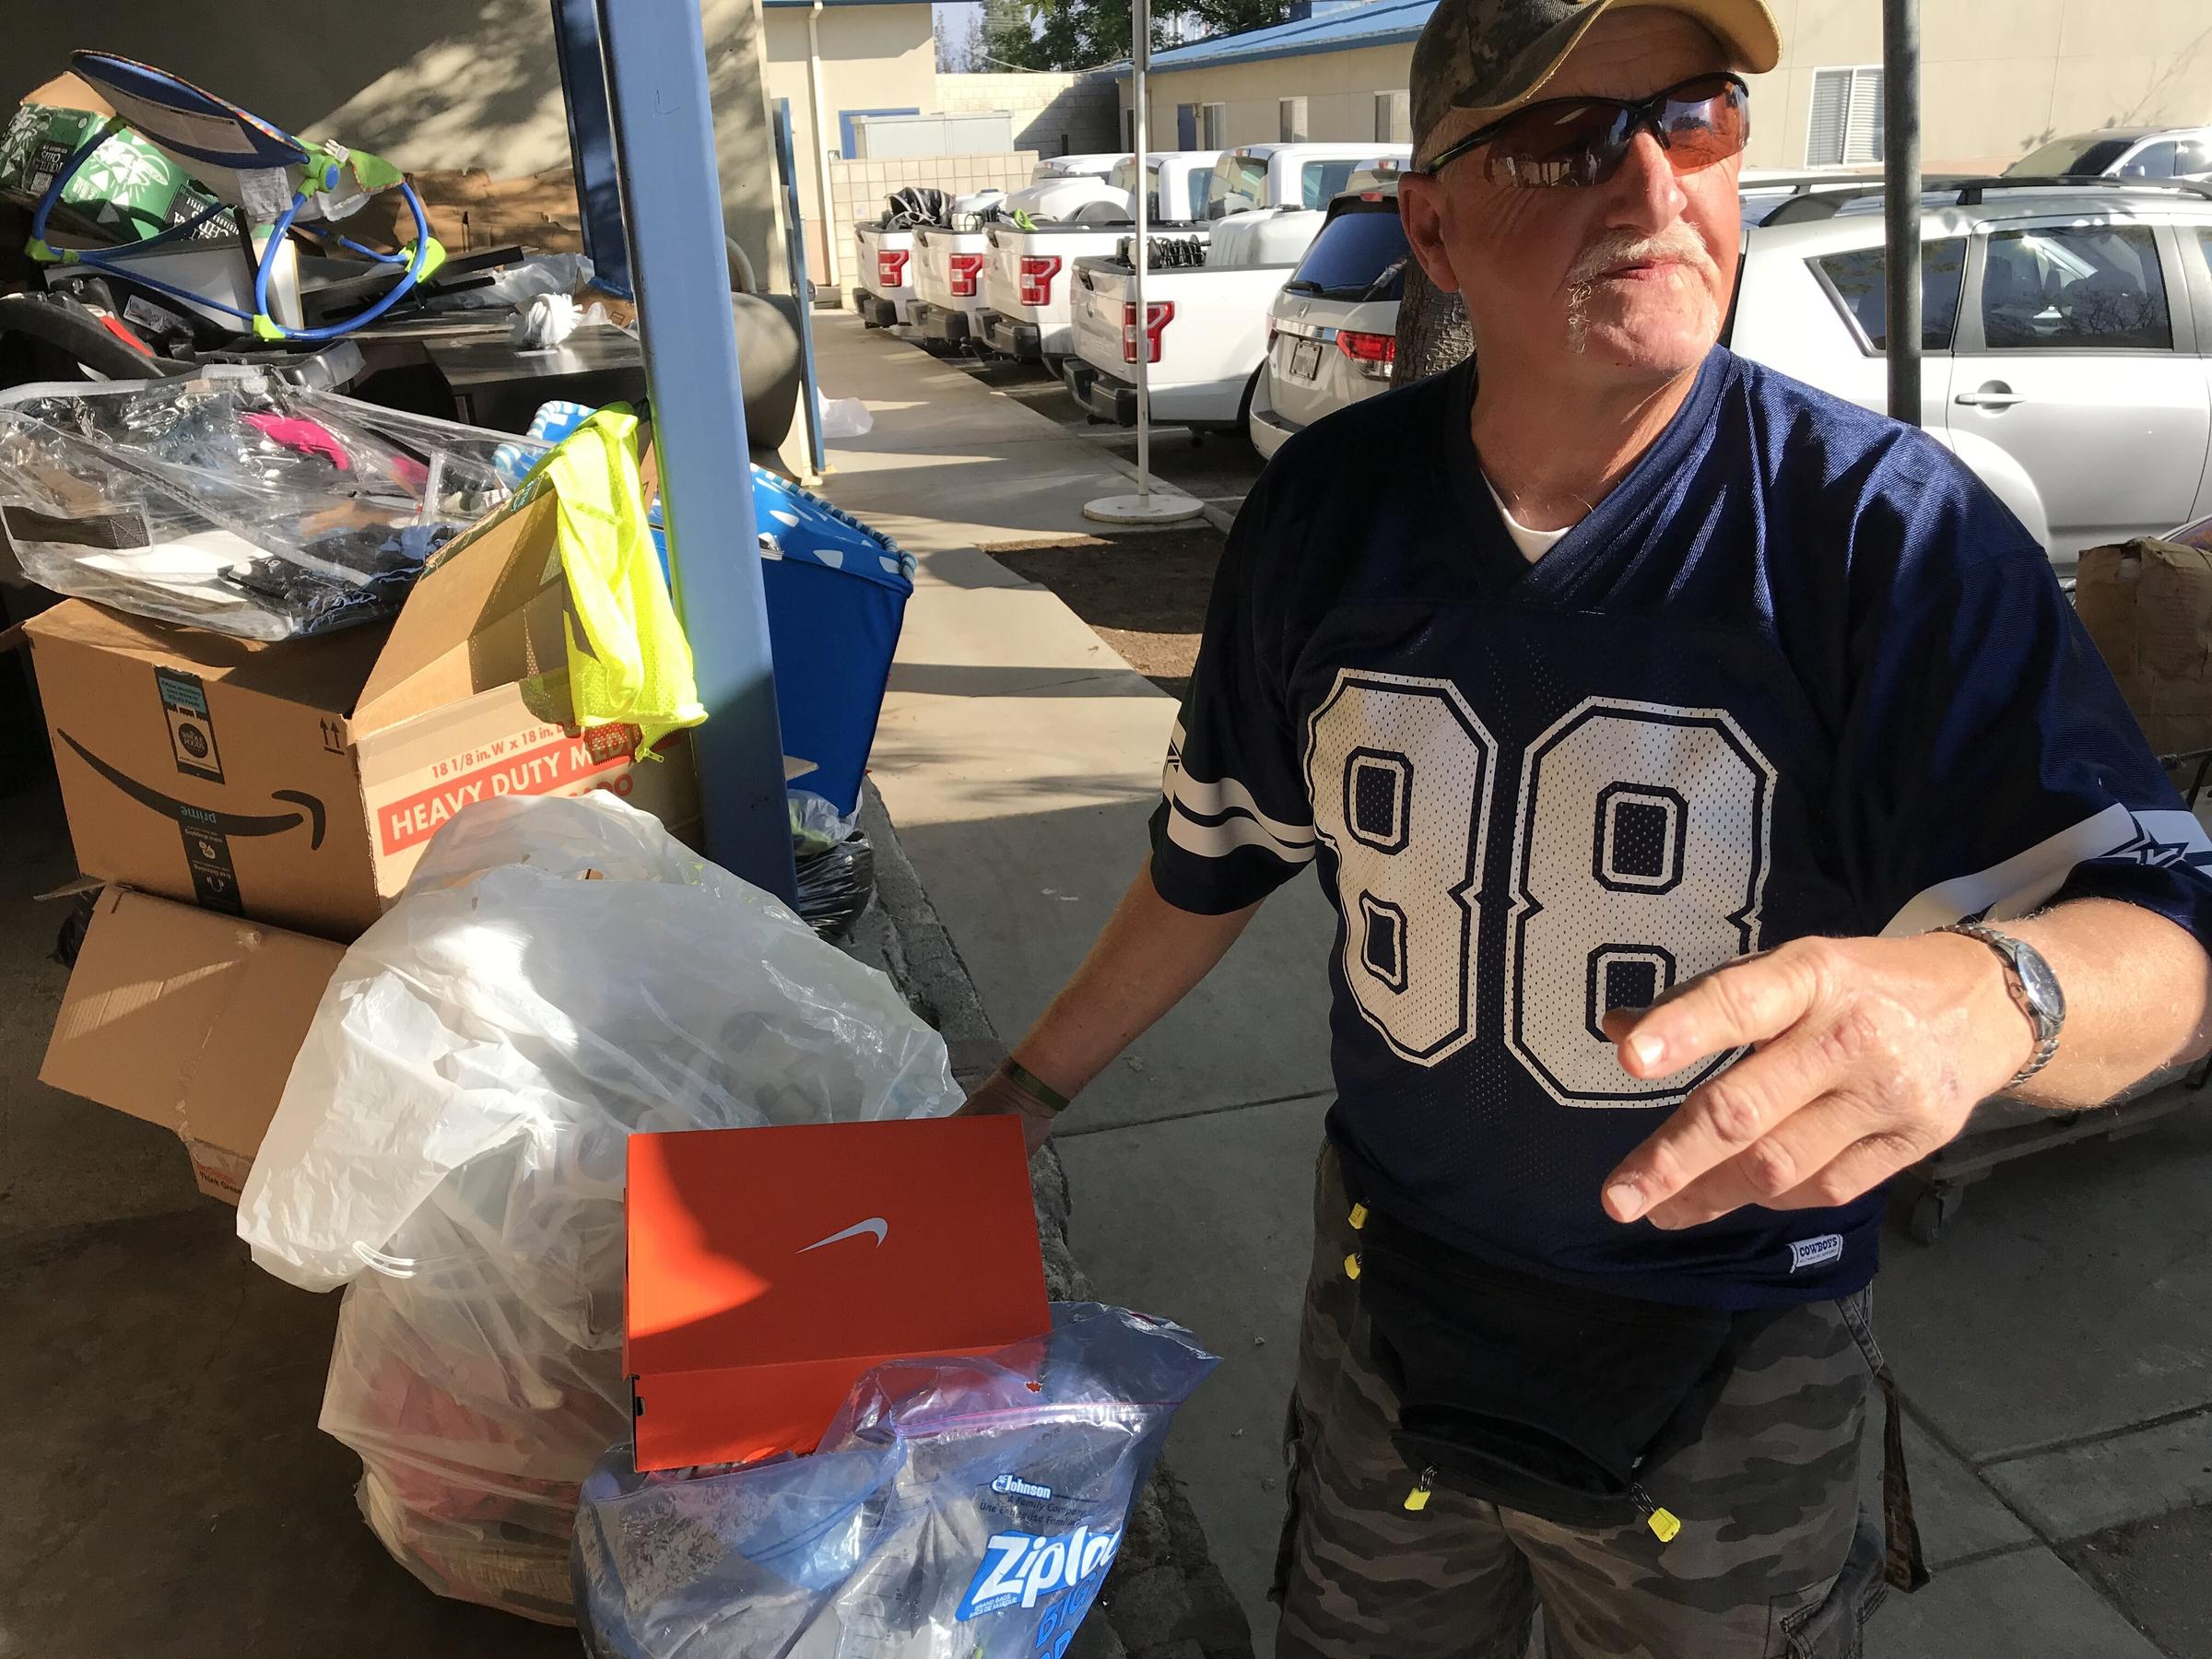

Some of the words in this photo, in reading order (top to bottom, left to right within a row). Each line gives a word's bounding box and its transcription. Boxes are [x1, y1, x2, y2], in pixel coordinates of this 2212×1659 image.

[432, 762, 449, 778] 18
[452, 753, 474, 771] 1/8
[477, 749, 491, 762] in.
[491, 741, 504, 756] W
[510, 740, 518, 750] x
[522, 730, 536, 746] 18
[391, 781, 483, 841] HEAVY
[491, 751, 560, 796] DUTY
[571, 727, 633, 771] MEDI
[181, 806, 217, 824] prime
[1305, 667, 1778, 1108] 88
[1799, 1237, 1838, 1257] COWBOYS
[1001, 1475, 1051, 1500] Johnson
[1017, 1497, 1045, 1512] Family
